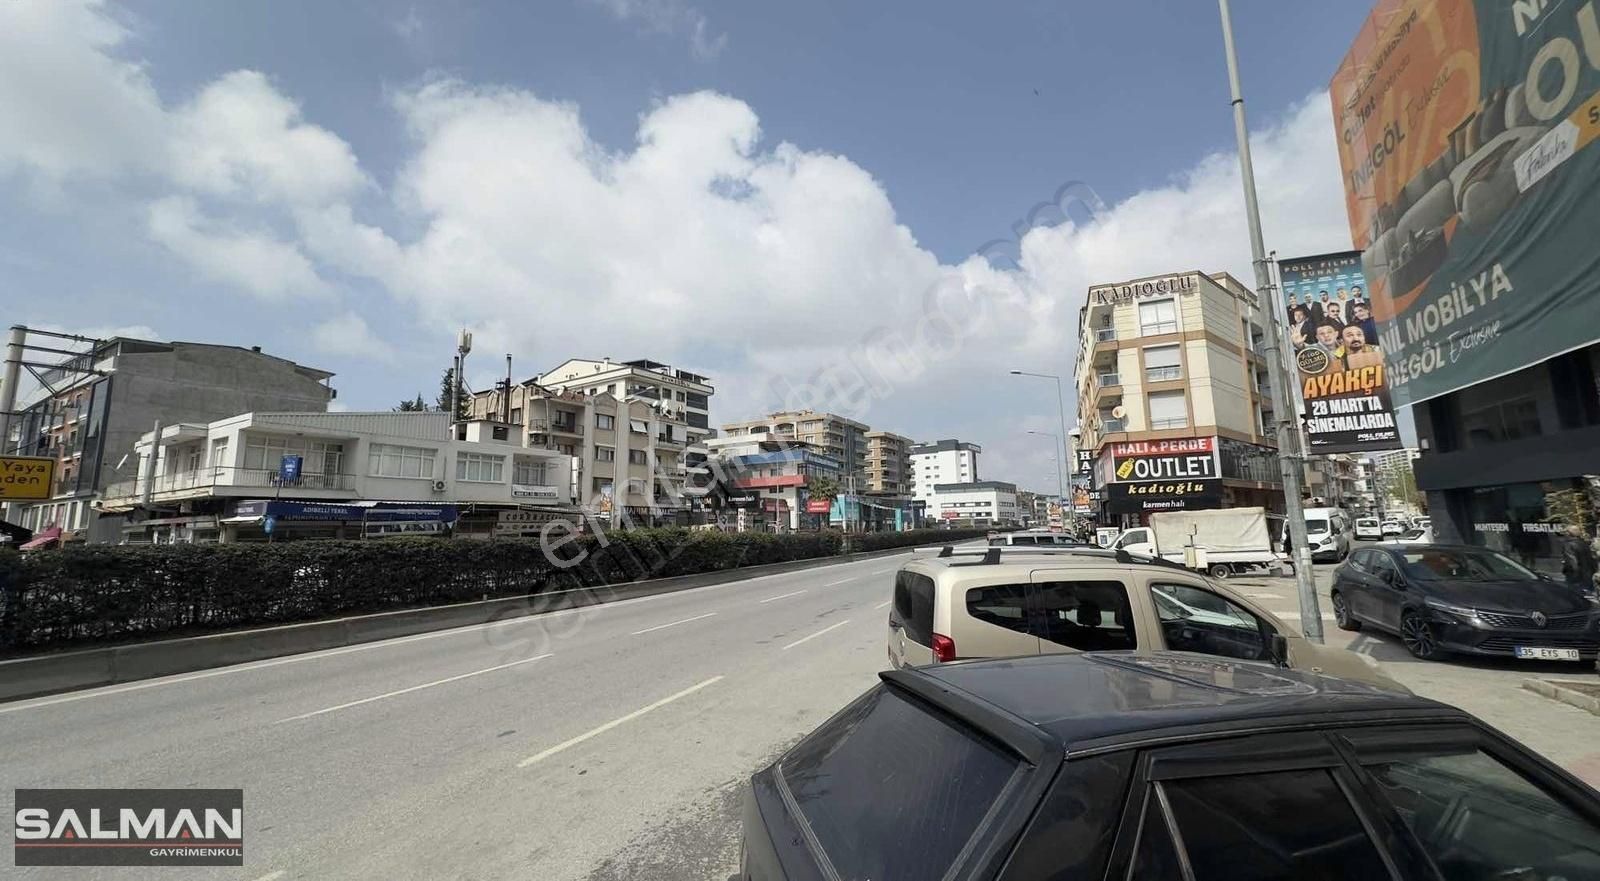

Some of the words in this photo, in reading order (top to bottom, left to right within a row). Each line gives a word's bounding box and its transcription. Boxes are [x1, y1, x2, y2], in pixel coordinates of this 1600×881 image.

[1284, 264, 1313, 273] POLL
[1321, 258, 1356, 267] FILMS
[1406, 262, 1514, 342] MOBİLYA
[1303, 365, 1383, 399] AYAKÇI
[1312, 400, 1328, 416] 28
[1329, 396, 1383, 415] MART'TA
[1307, 412, 1395, 434] SİNEMALARDA
[1118, 442, 1149, 455] HALI
[1160, 438, 1208, 452] PERDE
[3, 461, 46, 474] Yaya
[1135, 455, 1212, 478] OUTLET
[1128, 482, 1204, 495] kadıoğlu
[1521, 648, 1534, 656] 35
[1541, 649, 1559, 657] EYS
[1566, 650, 1577, 658] 10
